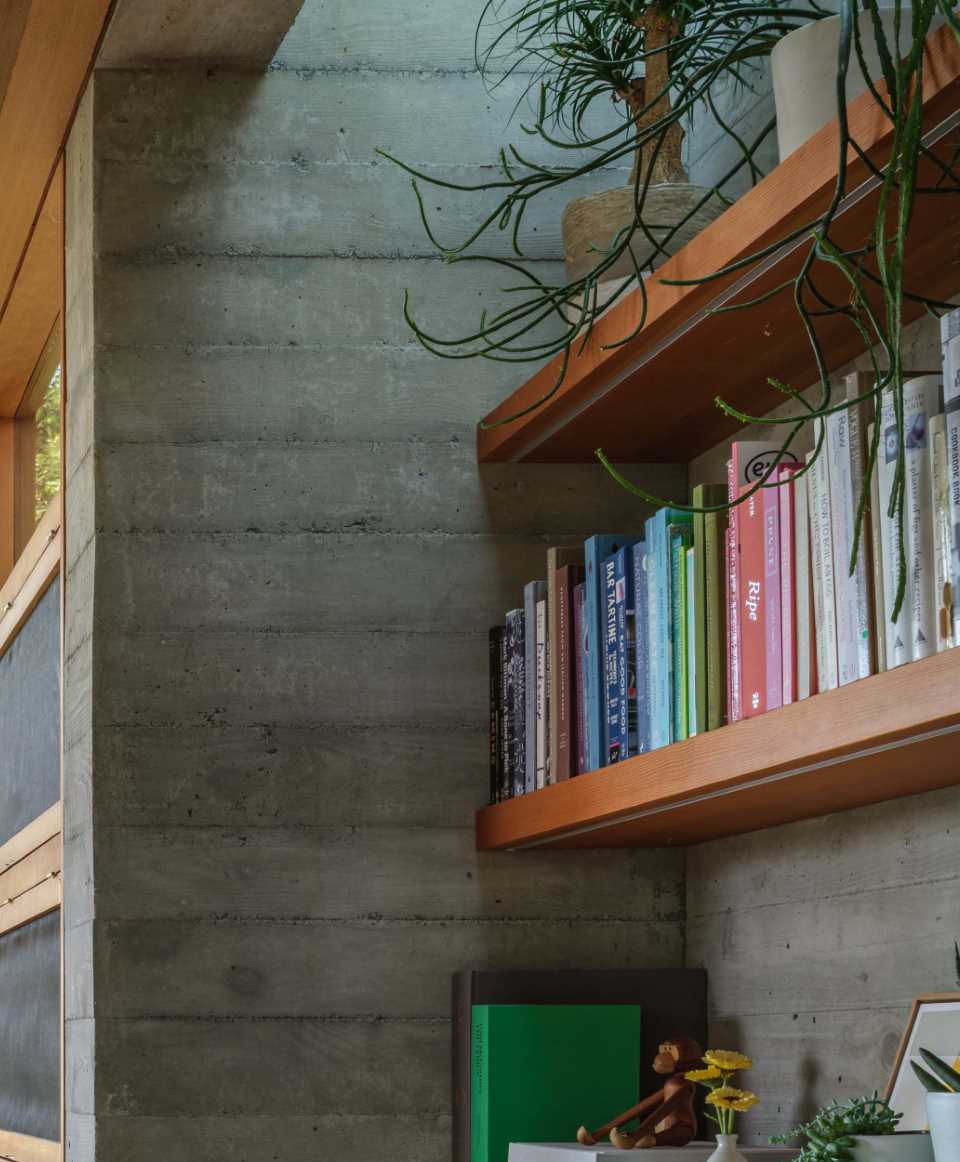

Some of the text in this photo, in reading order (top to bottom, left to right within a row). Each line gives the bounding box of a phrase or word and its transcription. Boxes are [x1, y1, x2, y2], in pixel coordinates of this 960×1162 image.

[606, 561, 616, 588] BAR
[607, 591, 617, 645] TARTINE
[746, 580, 761, 622] Ripe
